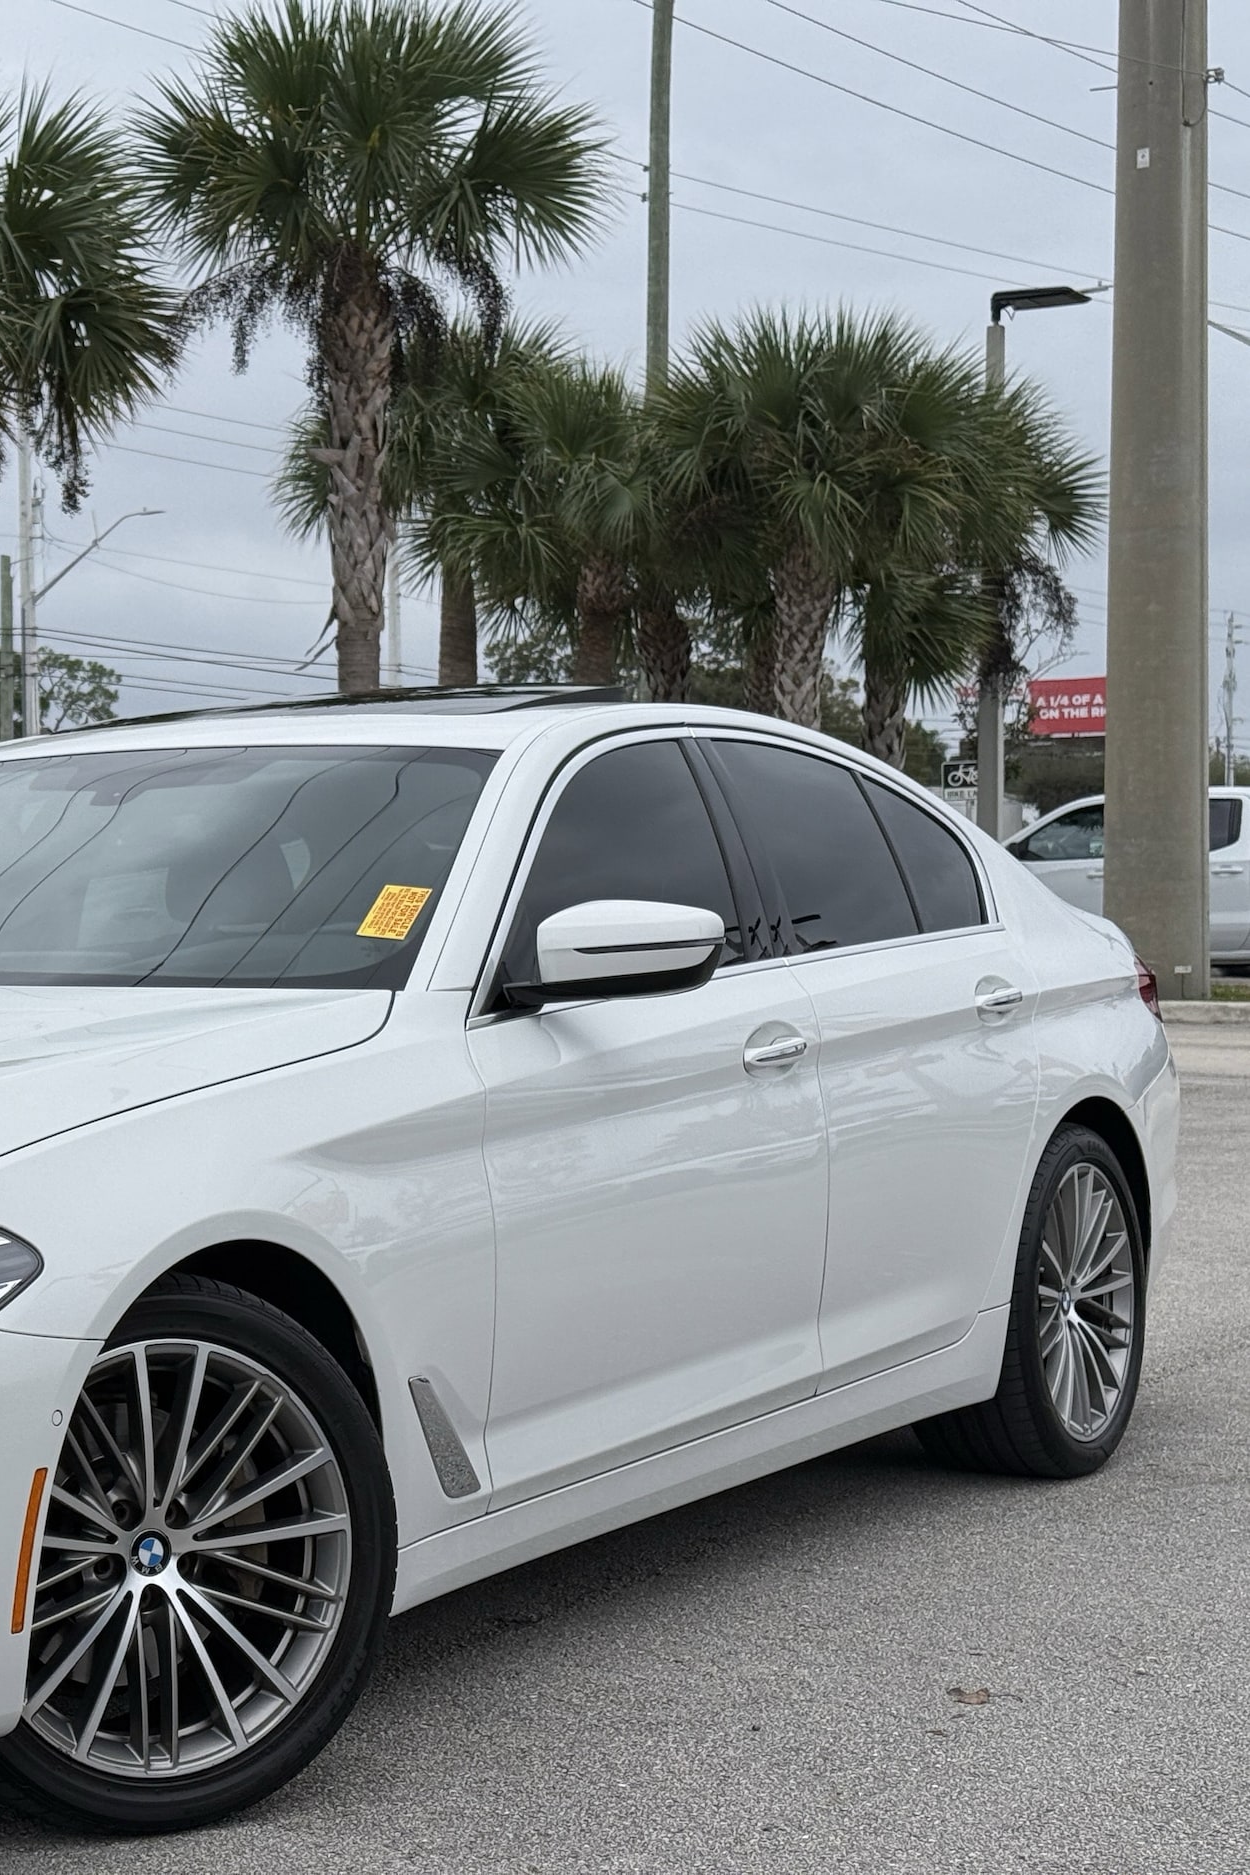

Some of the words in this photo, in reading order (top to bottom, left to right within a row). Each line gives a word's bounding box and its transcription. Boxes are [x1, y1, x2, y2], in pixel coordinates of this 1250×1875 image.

[1036, 696, 1046, 707] A
[1072, 694, 1090, 705] OF
[1093, 693, 1103, 705] A
[1039, 708, 1059, 720] ON
[1062, 707, 1088, 719] THE
[131, 1555, 163, 1574] BMW
